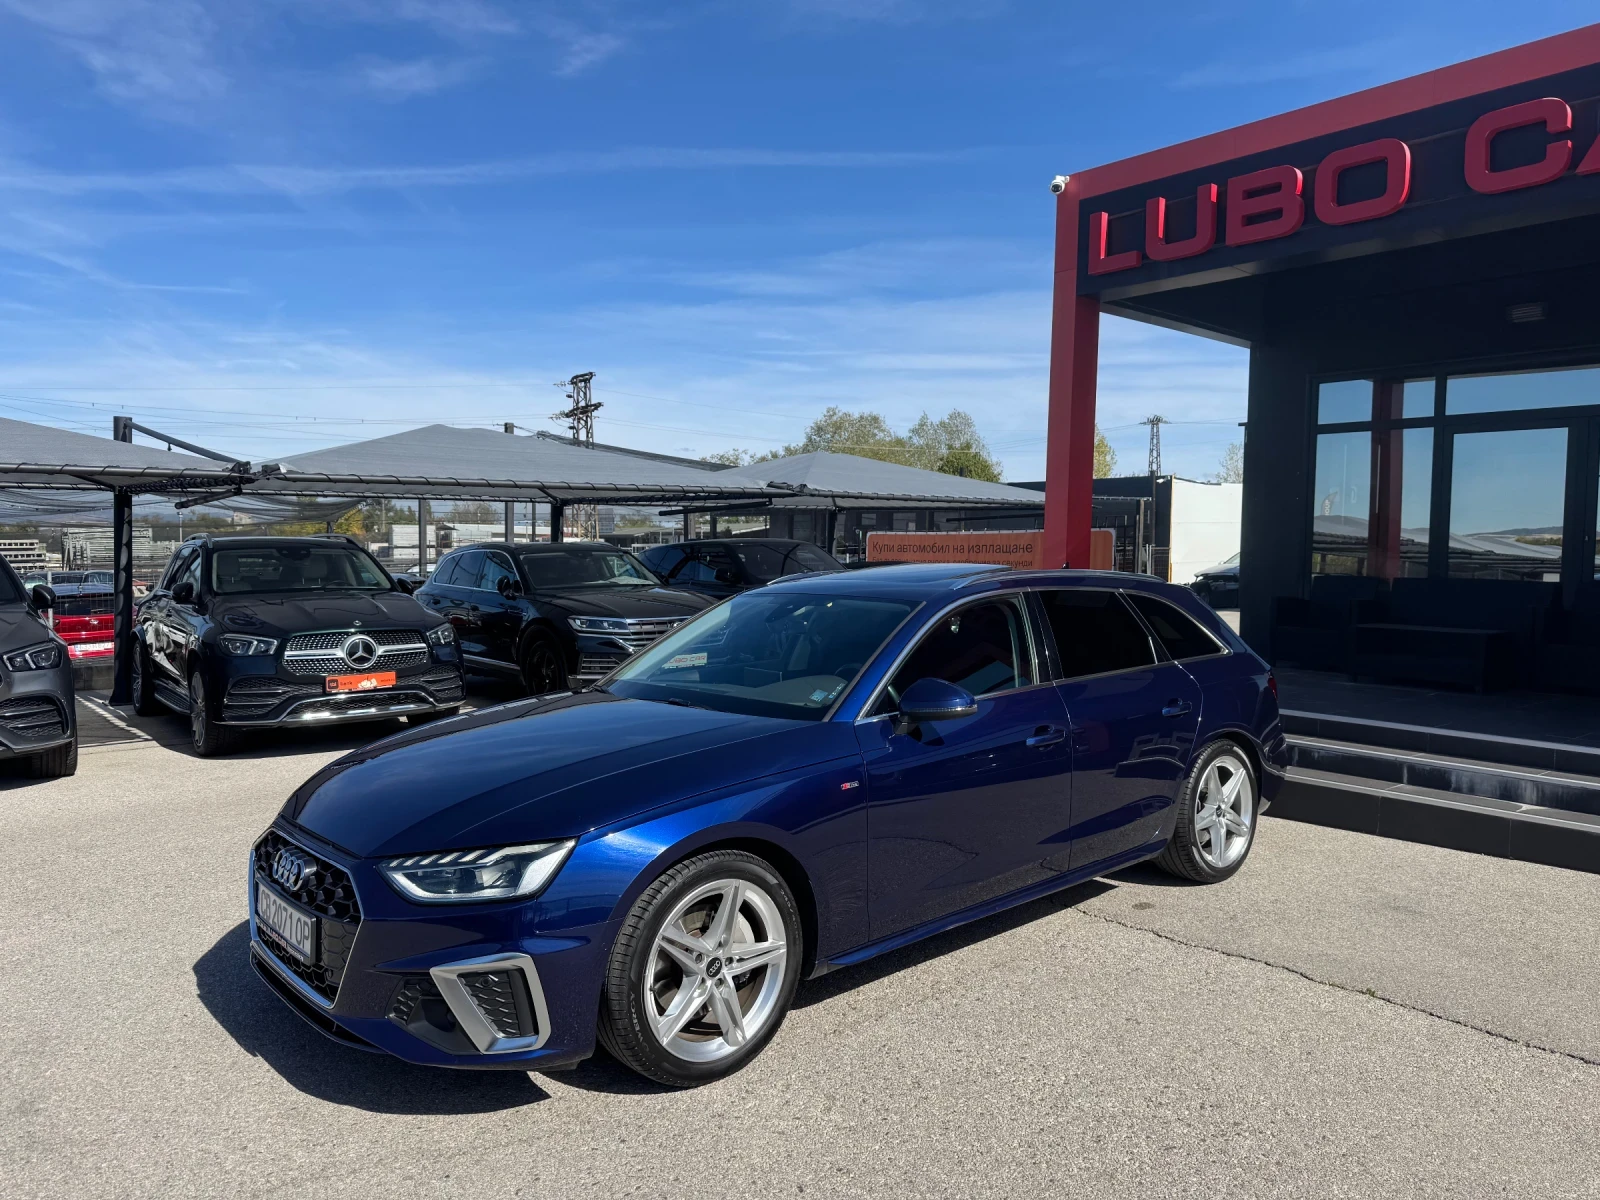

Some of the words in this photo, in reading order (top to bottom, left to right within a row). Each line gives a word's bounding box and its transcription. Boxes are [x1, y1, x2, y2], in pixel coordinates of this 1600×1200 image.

[1088, 138, 1411, 275] LUBO
[1464, 97, 1600, 195] C
[872, 541, 895, 554] Купи
[896, 542, 950, 554] автомобил
[952, 544, 965, 554] на
[967, 543, 1033, 555] изплащане
[272, 899, 293, 941] 2071
[295, 917, 310, 948] OP
